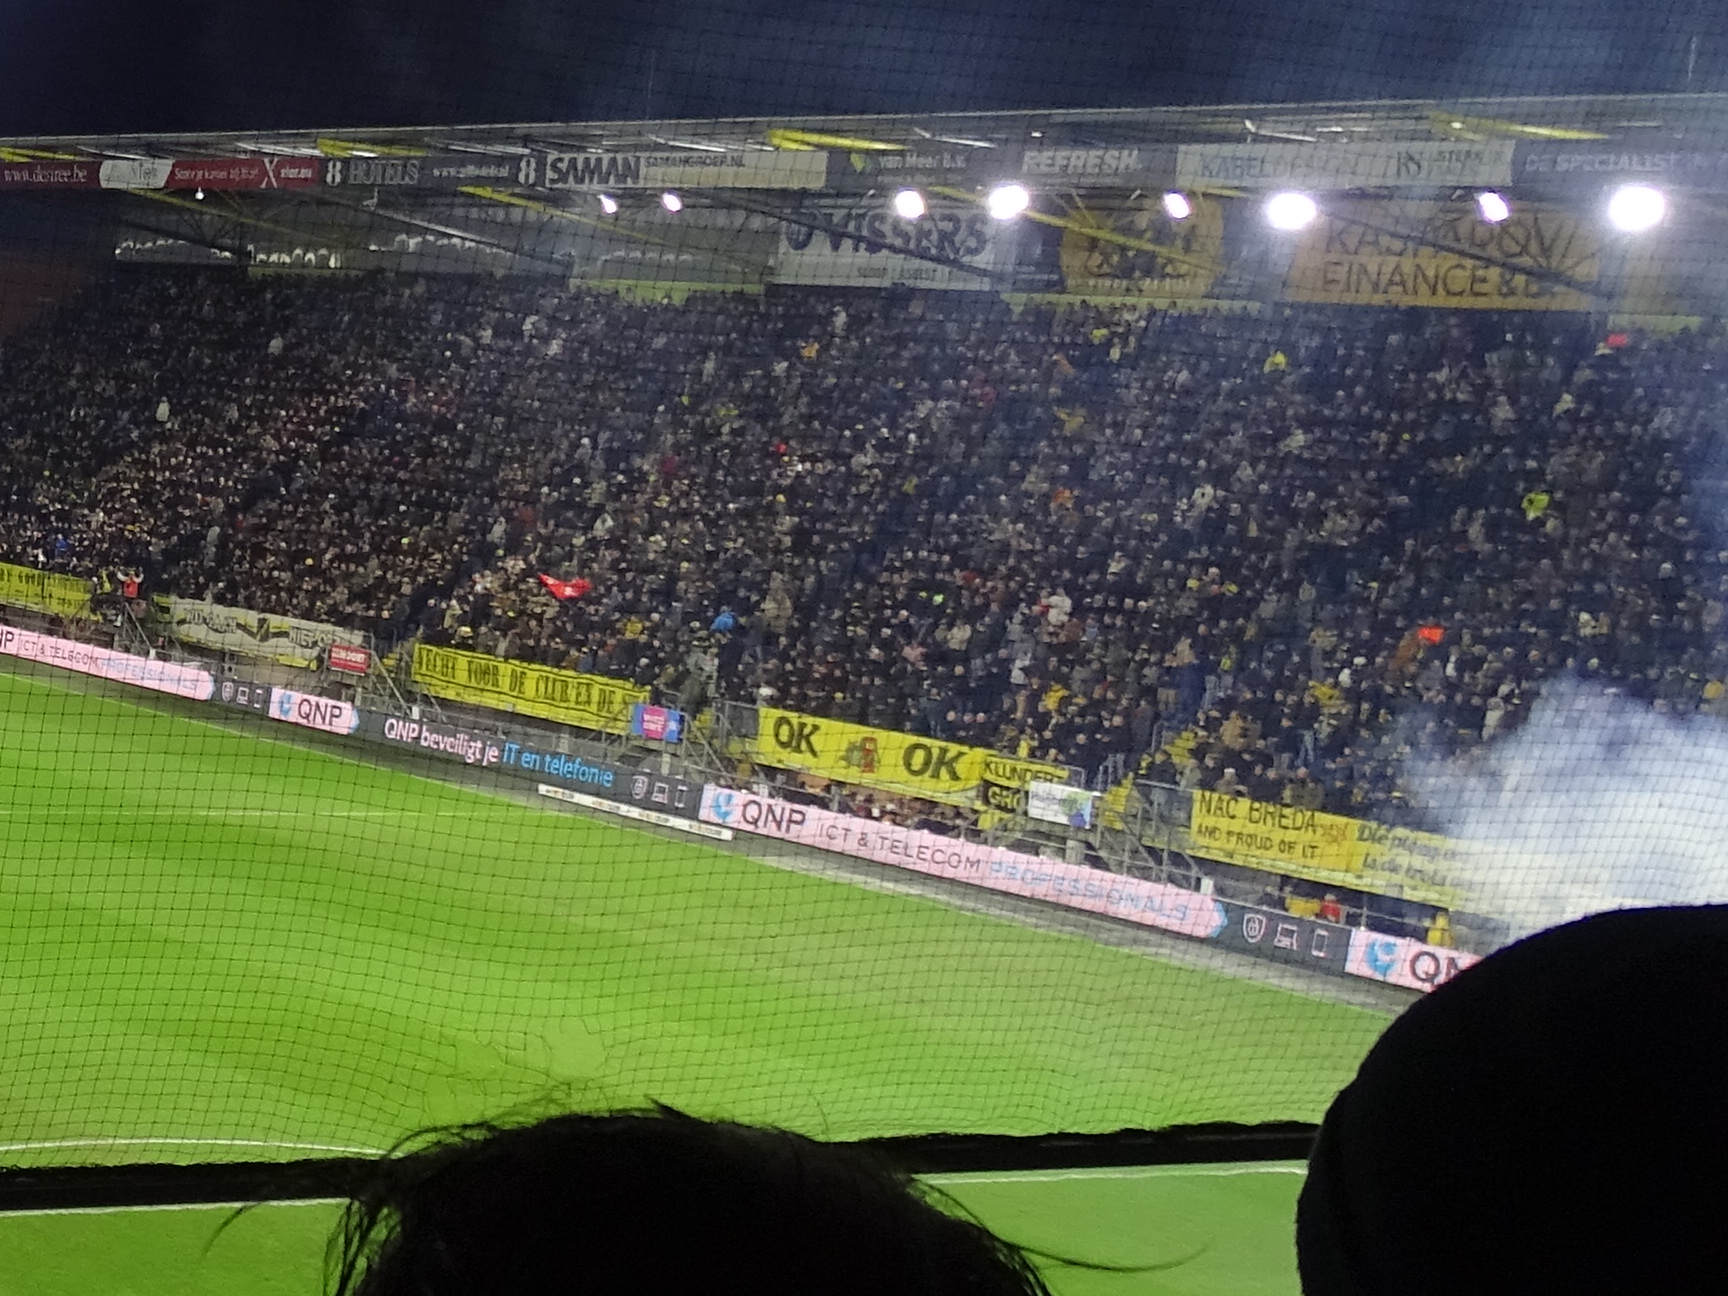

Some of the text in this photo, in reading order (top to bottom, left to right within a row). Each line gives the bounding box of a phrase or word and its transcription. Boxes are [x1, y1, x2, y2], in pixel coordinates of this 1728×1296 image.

[349, 160, 419, 185] HOTELS
[549, 156, 640, 186] SAMAN
[1320, 261, 1488, 297] FINANCE
[20, 636, 37, 652] ICT
[50, 643, 100, 667] TELECOM
[100, 656, 199, 693] PROFESSIONALS
[467, 659, 500, 689] VOOR
[509, 670, 527, 694] DE
[297, 697, 343, 727] QNP
[385, 718, 614, 789] QNP beveiligt je IT en telefonie
[772, 716, 820, 759] OK
[902, 743, 963, 782] OK
[1199, 794, 1318, 835] NAC BREDA
[742, 798, 806, 835] QNP
[818, 821, 852, 843] ICT
[857, 828, 871, 848] &
[877, 833, 981, 873] TELECOM
[989, 860, 1190, 923] PROFESSIONALS
[1196, 823, 1318, 860] AND PROUD OF IT
